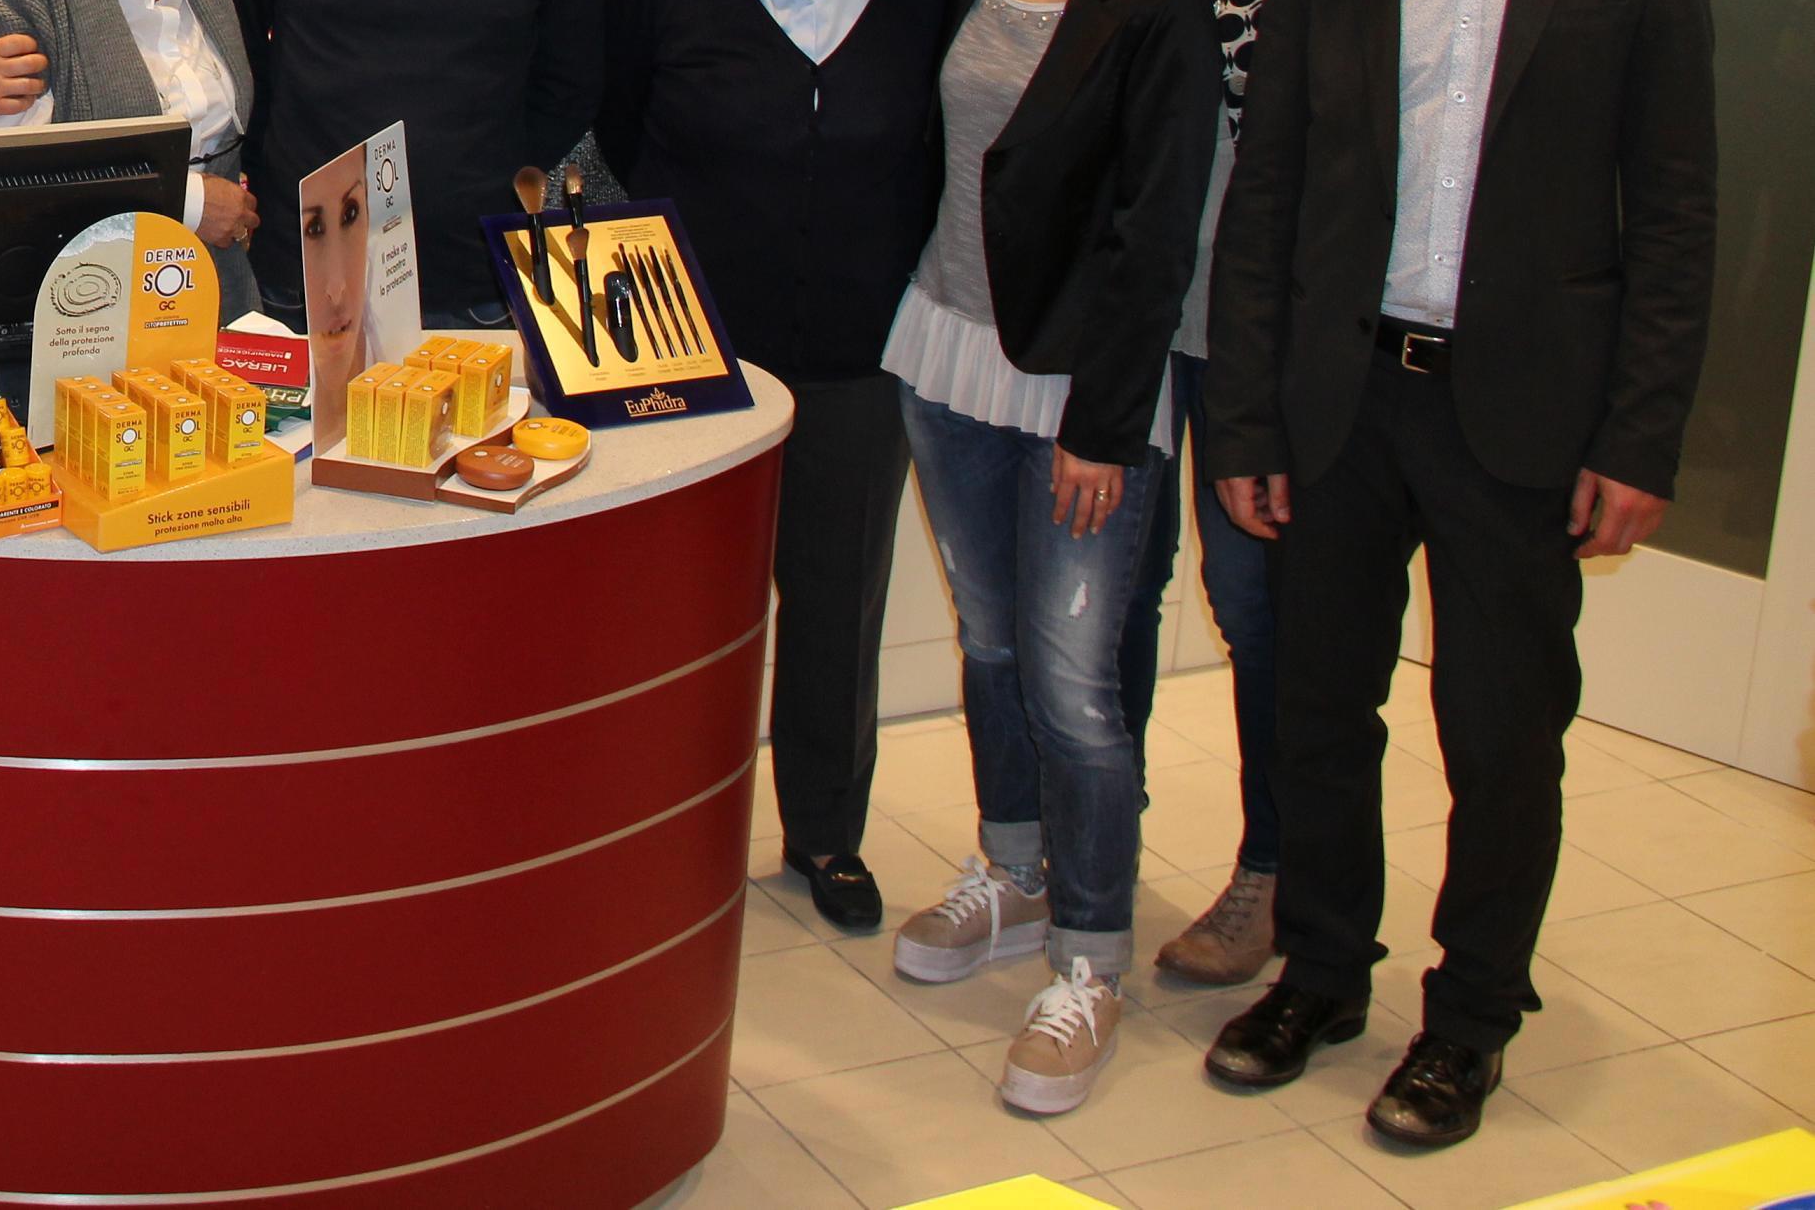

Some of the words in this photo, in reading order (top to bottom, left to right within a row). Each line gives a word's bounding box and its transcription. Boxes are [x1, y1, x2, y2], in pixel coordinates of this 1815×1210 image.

[374, 140, 396, 161] DERMA
[375, 158, 399, 193] SOL
[145, 249, 196, 263] DERMA
[385, 246, 400, 262] make
[400, 242, 408, 255] up
[385, 258, 406, 277] incontra
[143, 264, 194, 296] SOL
[159, 300, 177, 311] GC
[56, 325, 77, 336] Sotto
[78, 325, 85, 335] il
[85, 324, 110, 336] segno
[49, 336, 70, 347] della
[71, 335, 115, 347] protezione
[62, 346, 101, 358] profonda
[218, 347, 284, 359] MAGNIFICENCE
[221, 359, 288, 373] LIERAC
[236, 401, 262, 410] DERMA
[624, 394, 686, 415] EuPhidra
[175, 410, 202, 419] DERMA
[235, 409, 261, 426] SOL
[116, 420, 143, 429] DERMA
[175, 418, 201, 435] SOL
[115, 428, 142, 445] SOL
[24, 503, 52, 513] COLORATO
[147, 509, 174, 525] Stick
[176, 509, 204, 521] zone
[206, 499, 251, 517] sensibili
[154, 522, 200, 537] protezione
[201, 518, 226, 529] molto
[226, 514, 243, 524] alta
